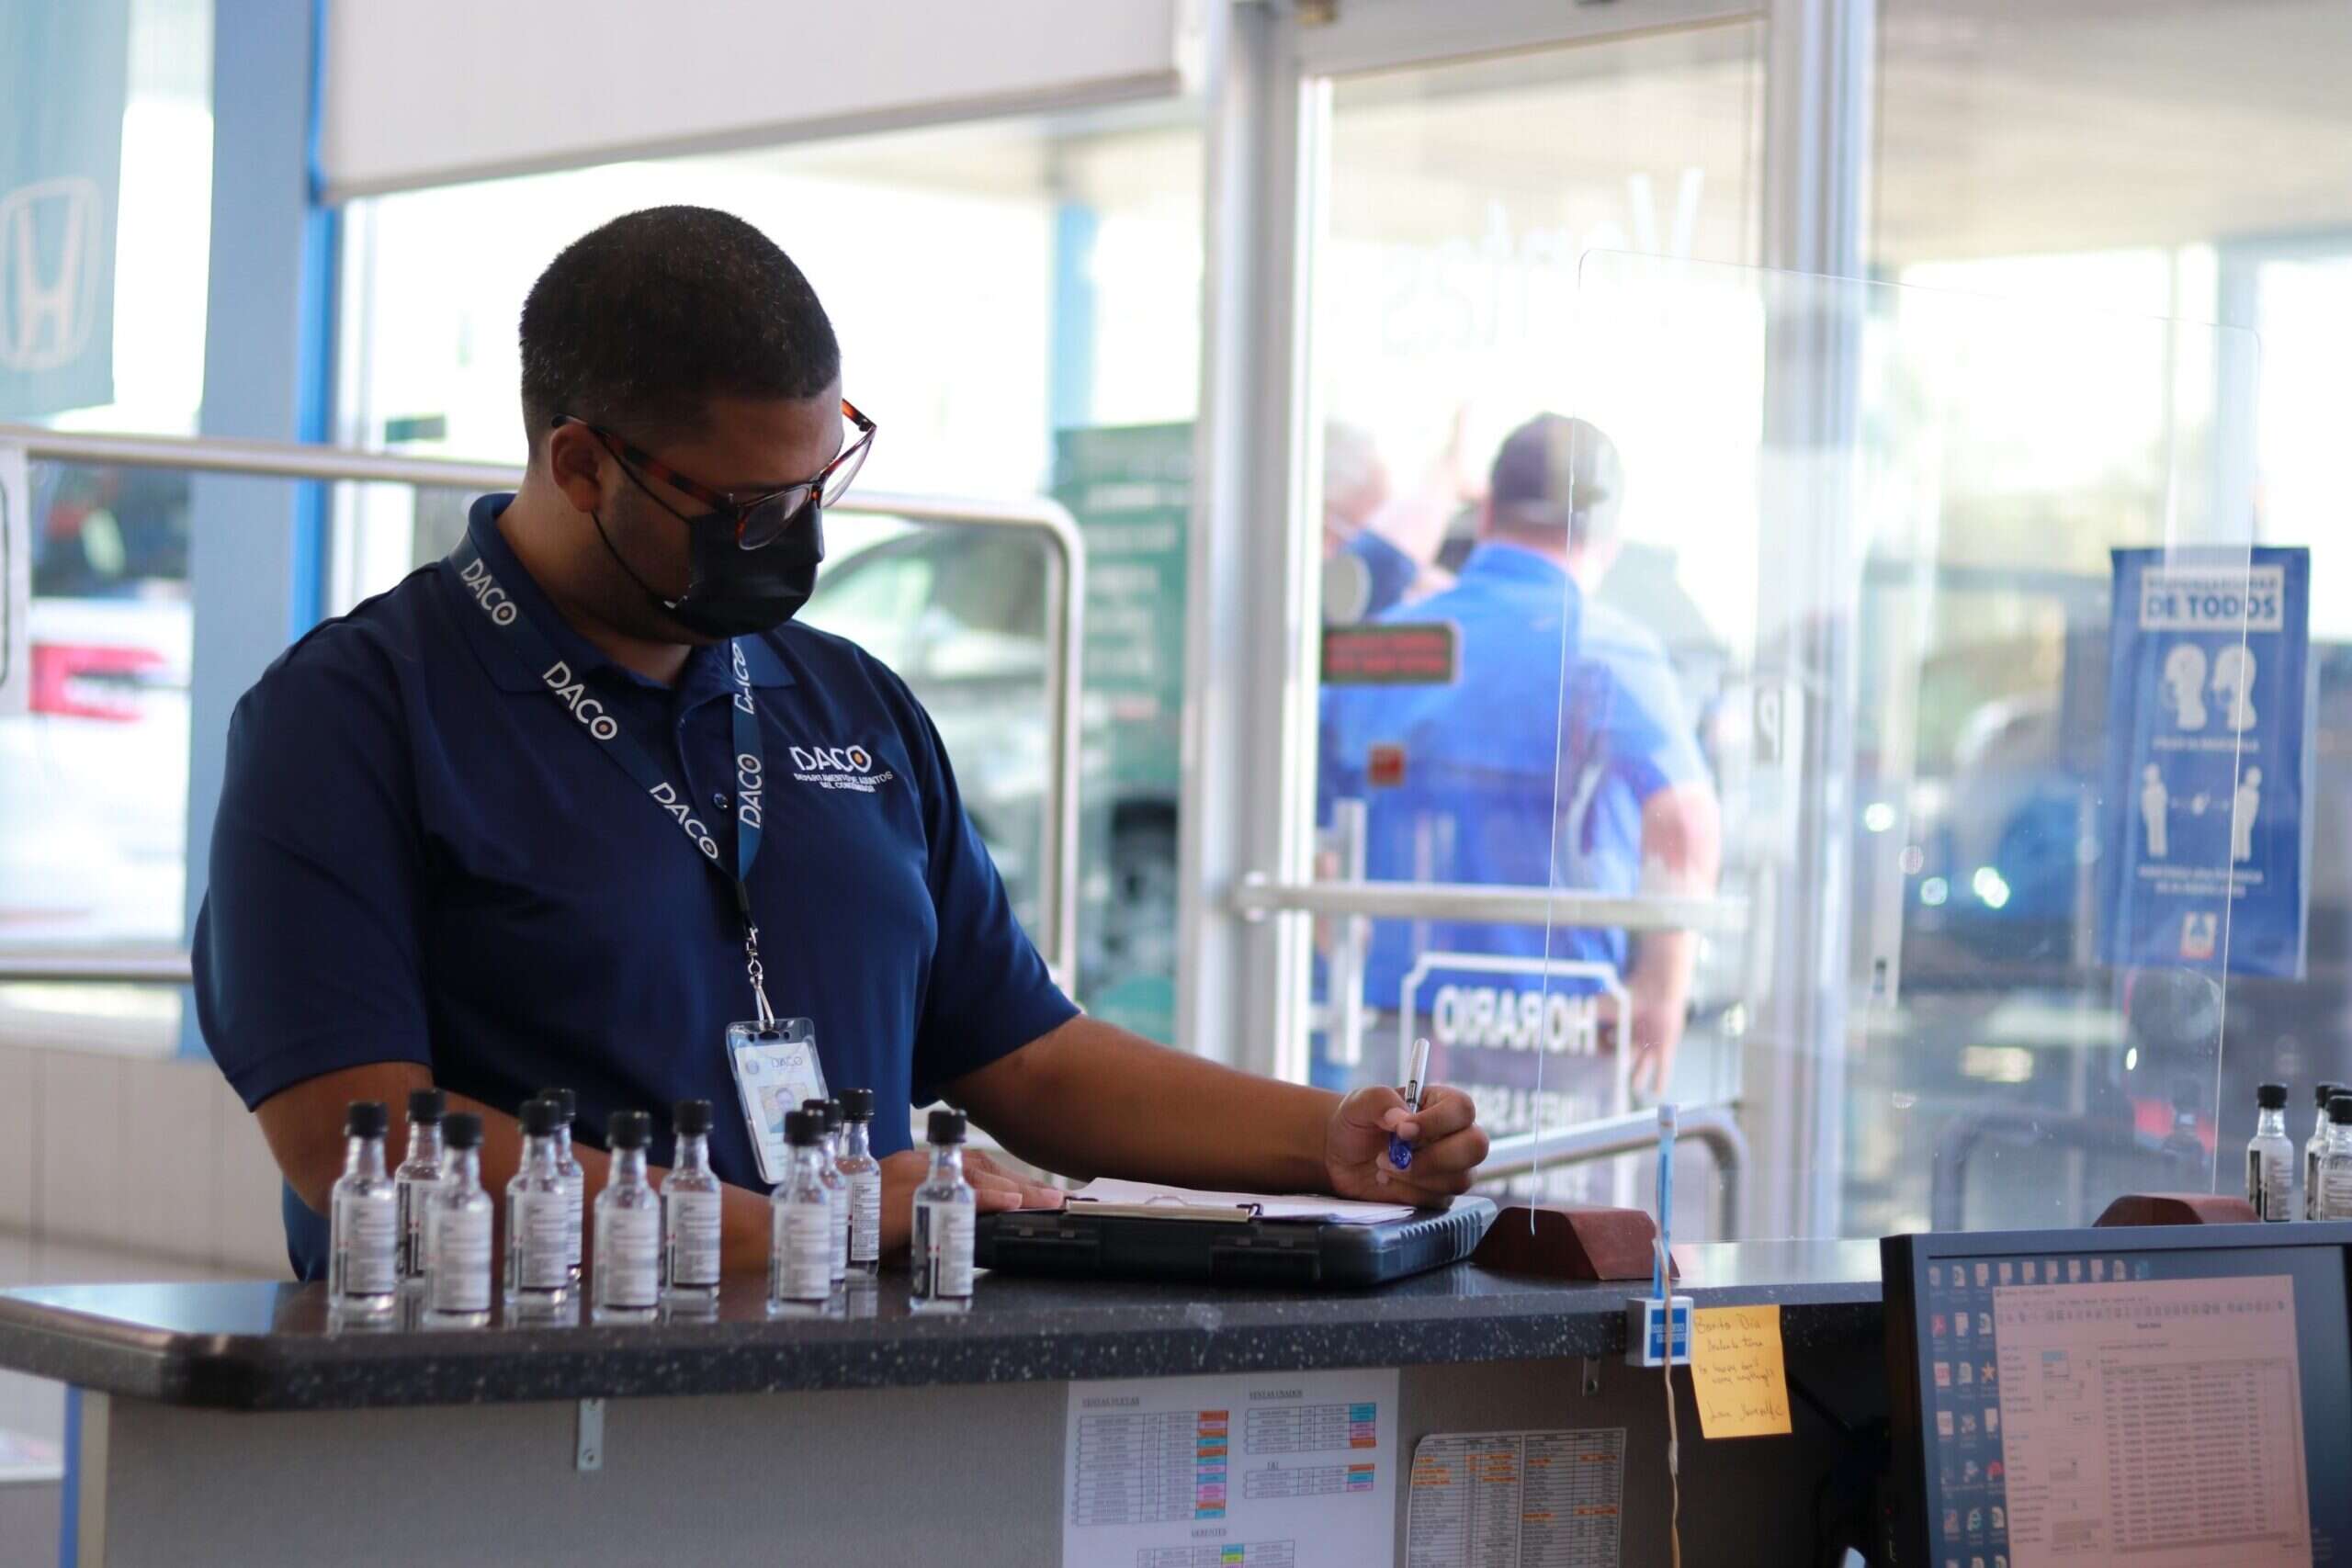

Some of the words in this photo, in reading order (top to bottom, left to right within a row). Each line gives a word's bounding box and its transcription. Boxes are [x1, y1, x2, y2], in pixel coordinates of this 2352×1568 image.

[460, 558, 517, 626] DACO
[2146, 594, 2177, 618] DE
[2188, 594, 2277, 620] TODOS
[542, 660, 618, 740] DACO
[737, 753, 763, 829] DACO
[788, 745, 872, 773] DACO
[649, 782, 719, 861] DACO
